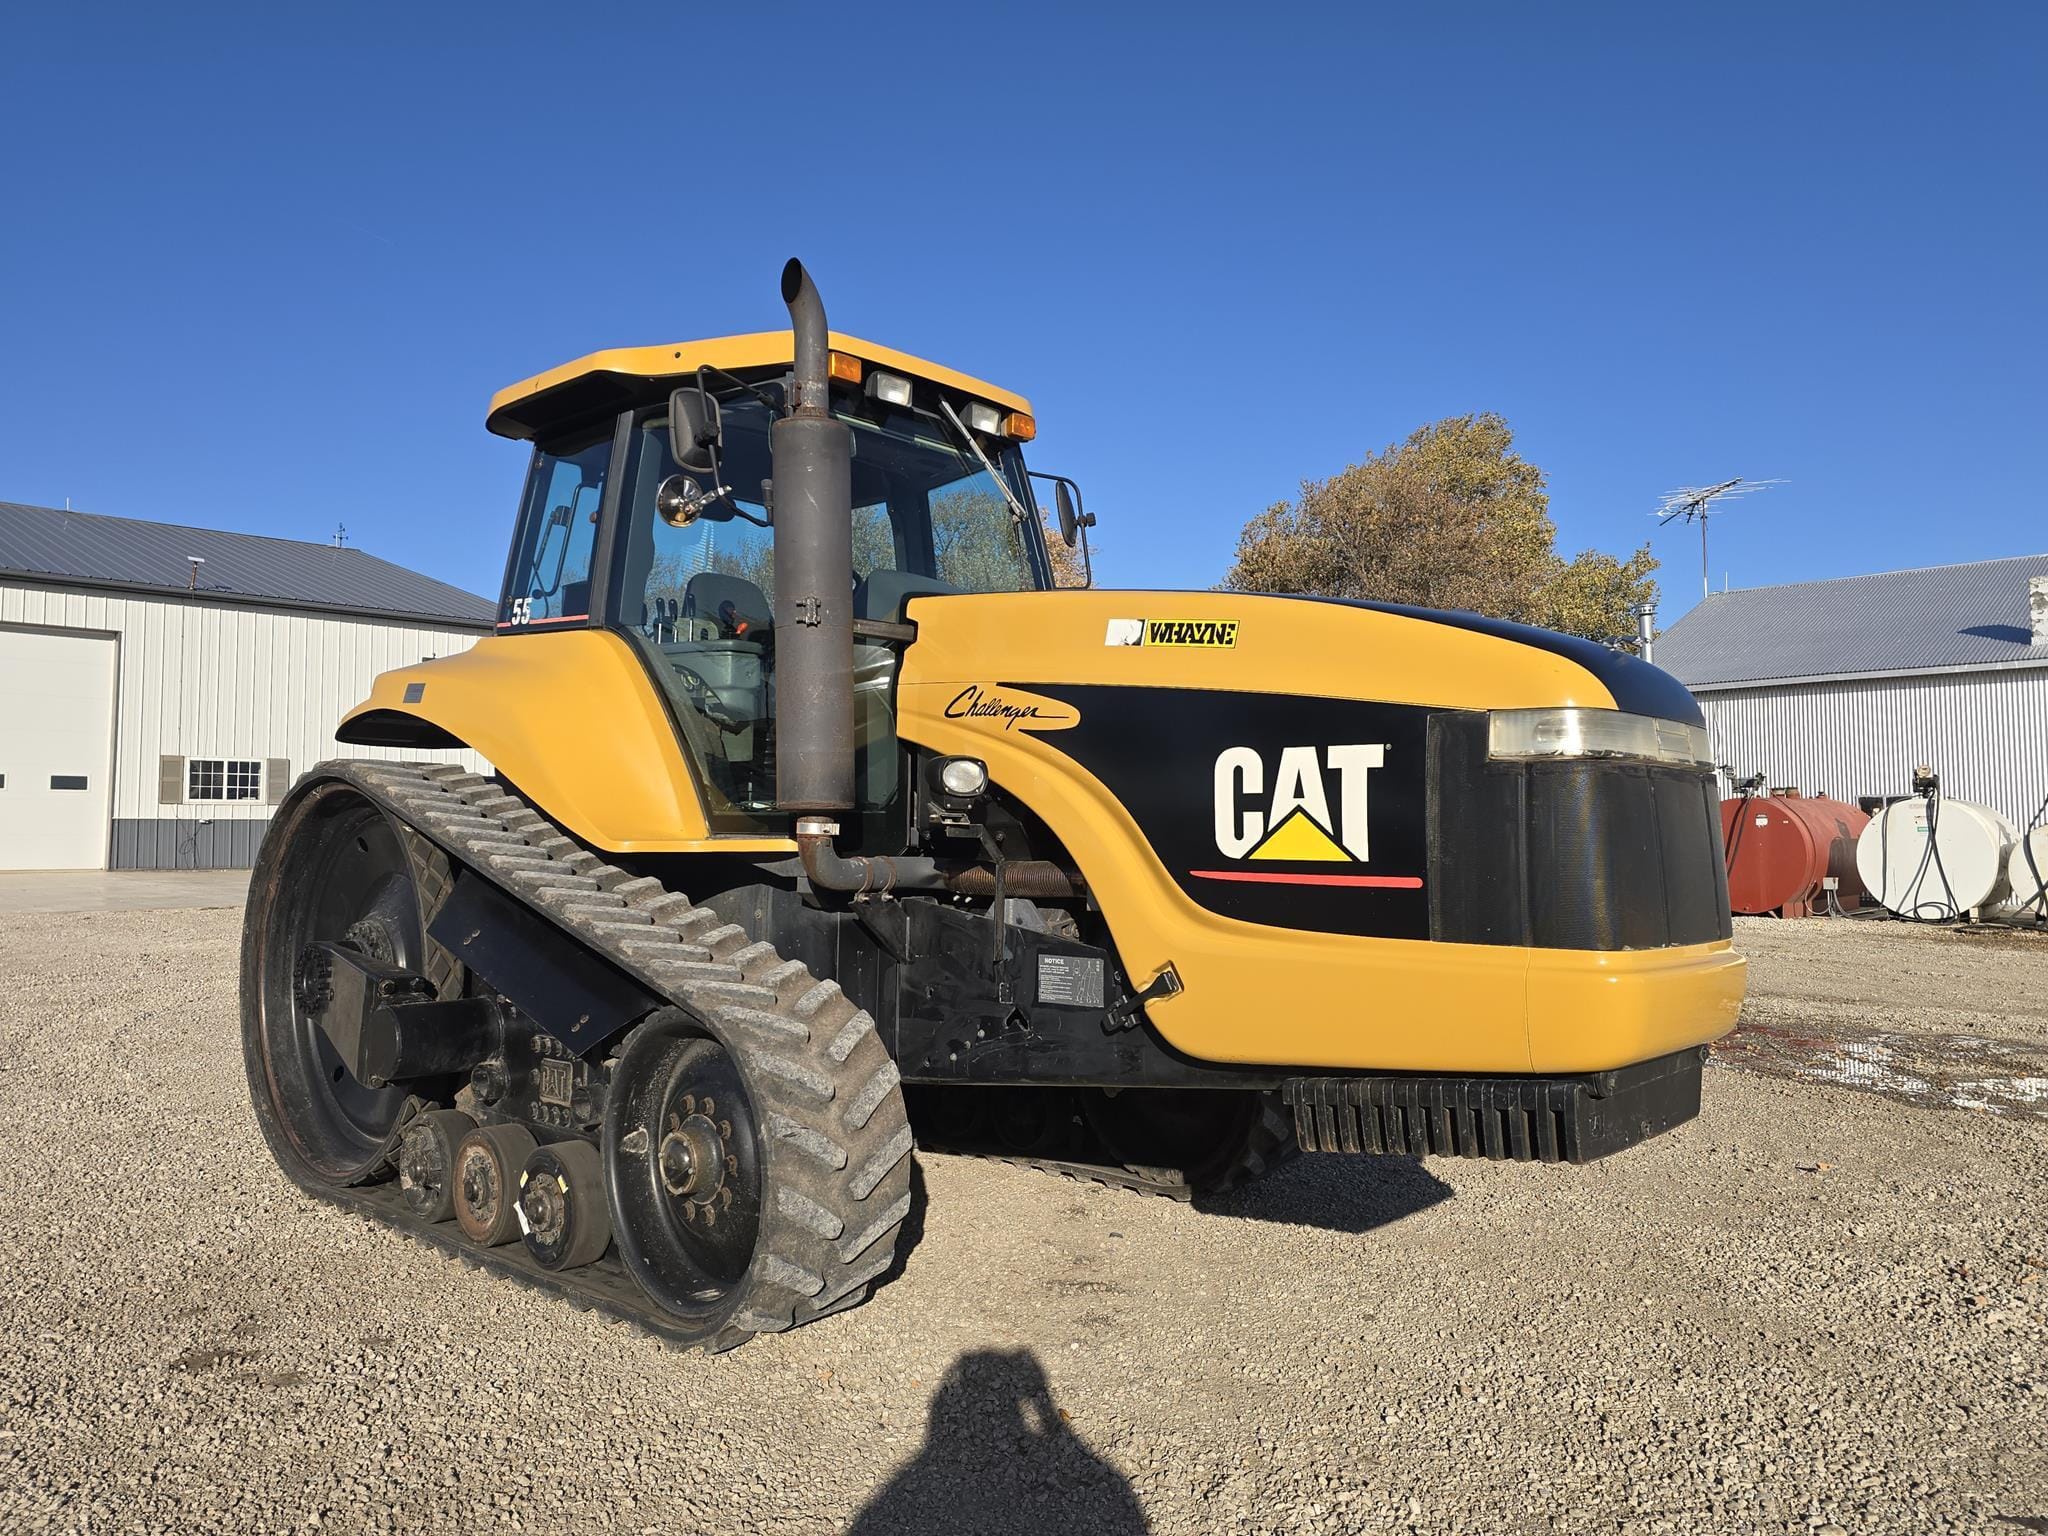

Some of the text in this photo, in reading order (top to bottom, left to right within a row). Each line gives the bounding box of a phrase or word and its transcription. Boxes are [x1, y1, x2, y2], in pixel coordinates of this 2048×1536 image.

[511, 597, 532, 625] 55
[1150, 622, 1236, 645] WHAYNE
[944, 685, 1069, 730] Challenger
[1213, 743, 1385, 862] CAT
[1044, 957, 1065, 965] NOTICE
[542, 1065, 566, 1099] CAT
